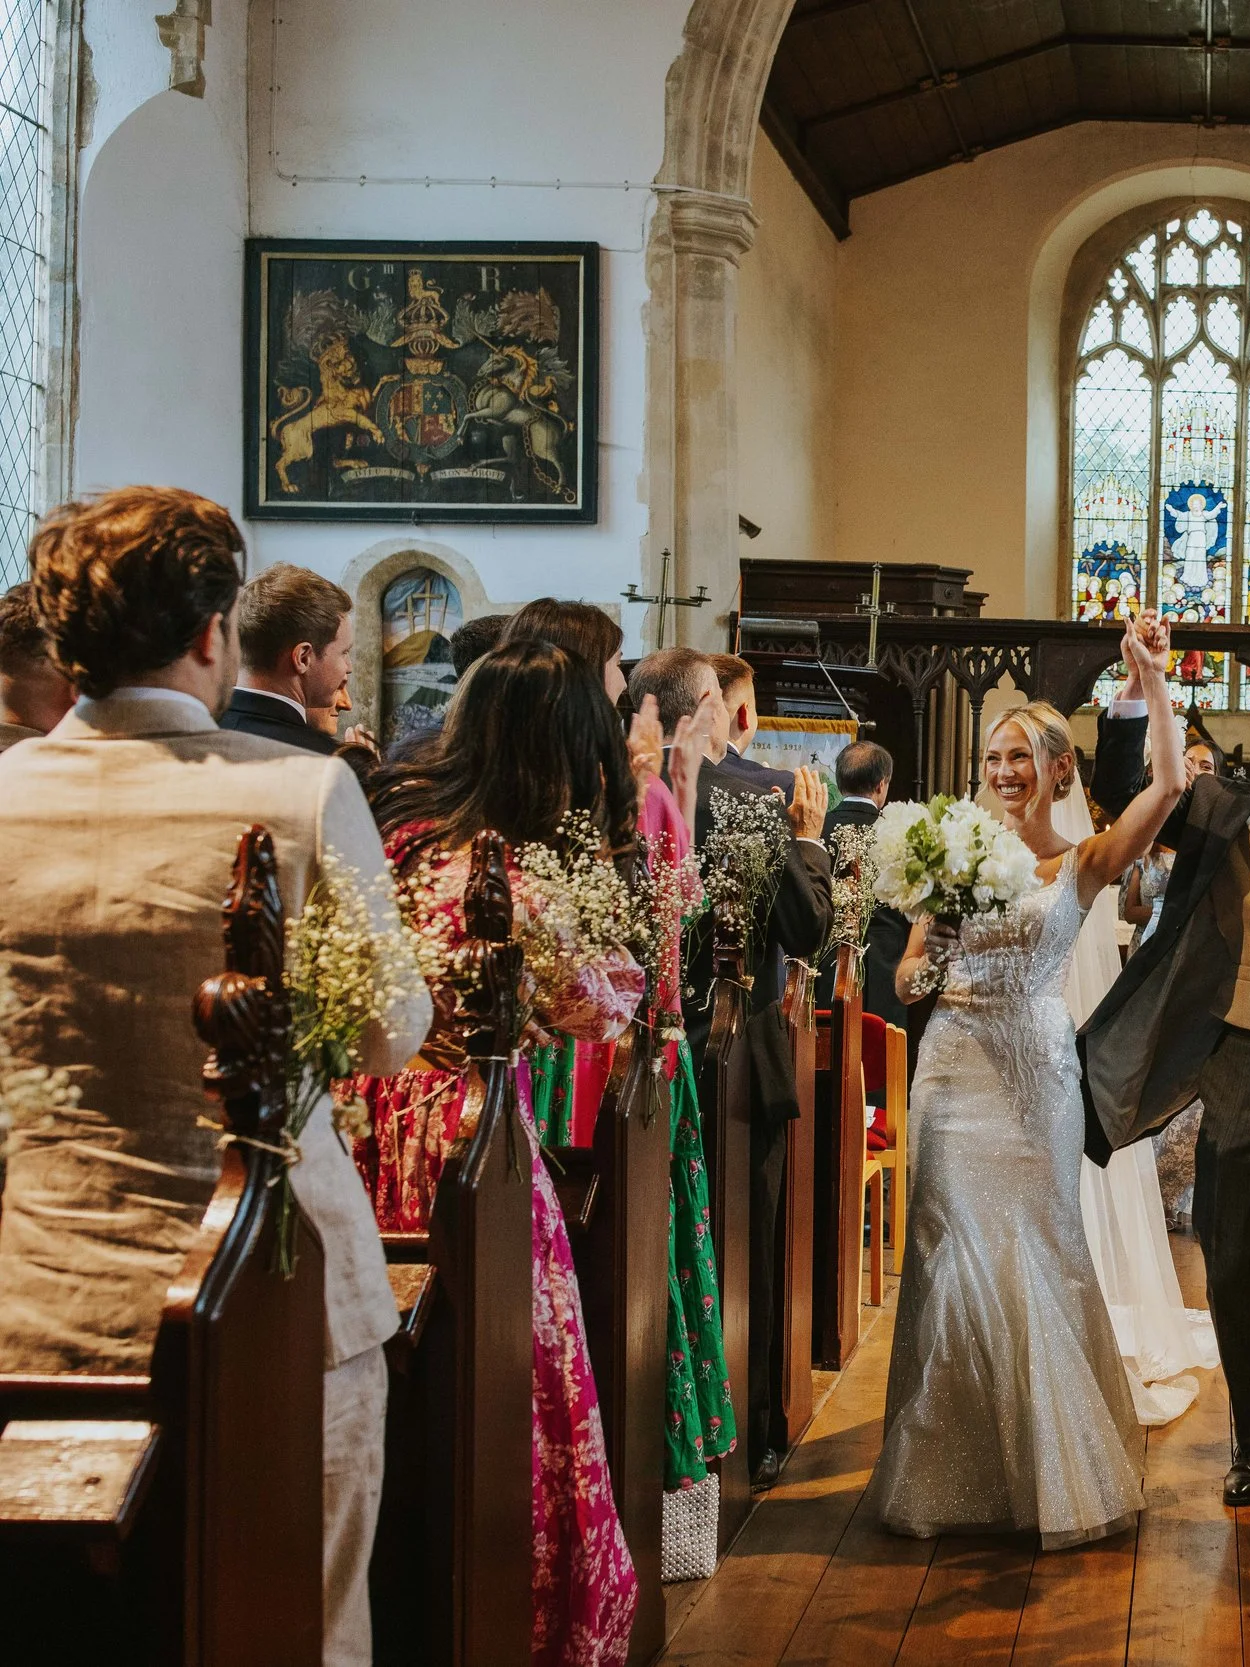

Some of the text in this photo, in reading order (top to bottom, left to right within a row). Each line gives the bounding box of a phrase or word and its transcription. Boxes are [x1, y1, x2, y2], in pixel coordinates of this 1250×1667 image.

[349, 264, 372, 291] G
[476, 264, 501, 292] R
[440, 468, 460, 478] MON
[752, 742, 771, 750] 1914
[783, 743, 802, 751] 1918
